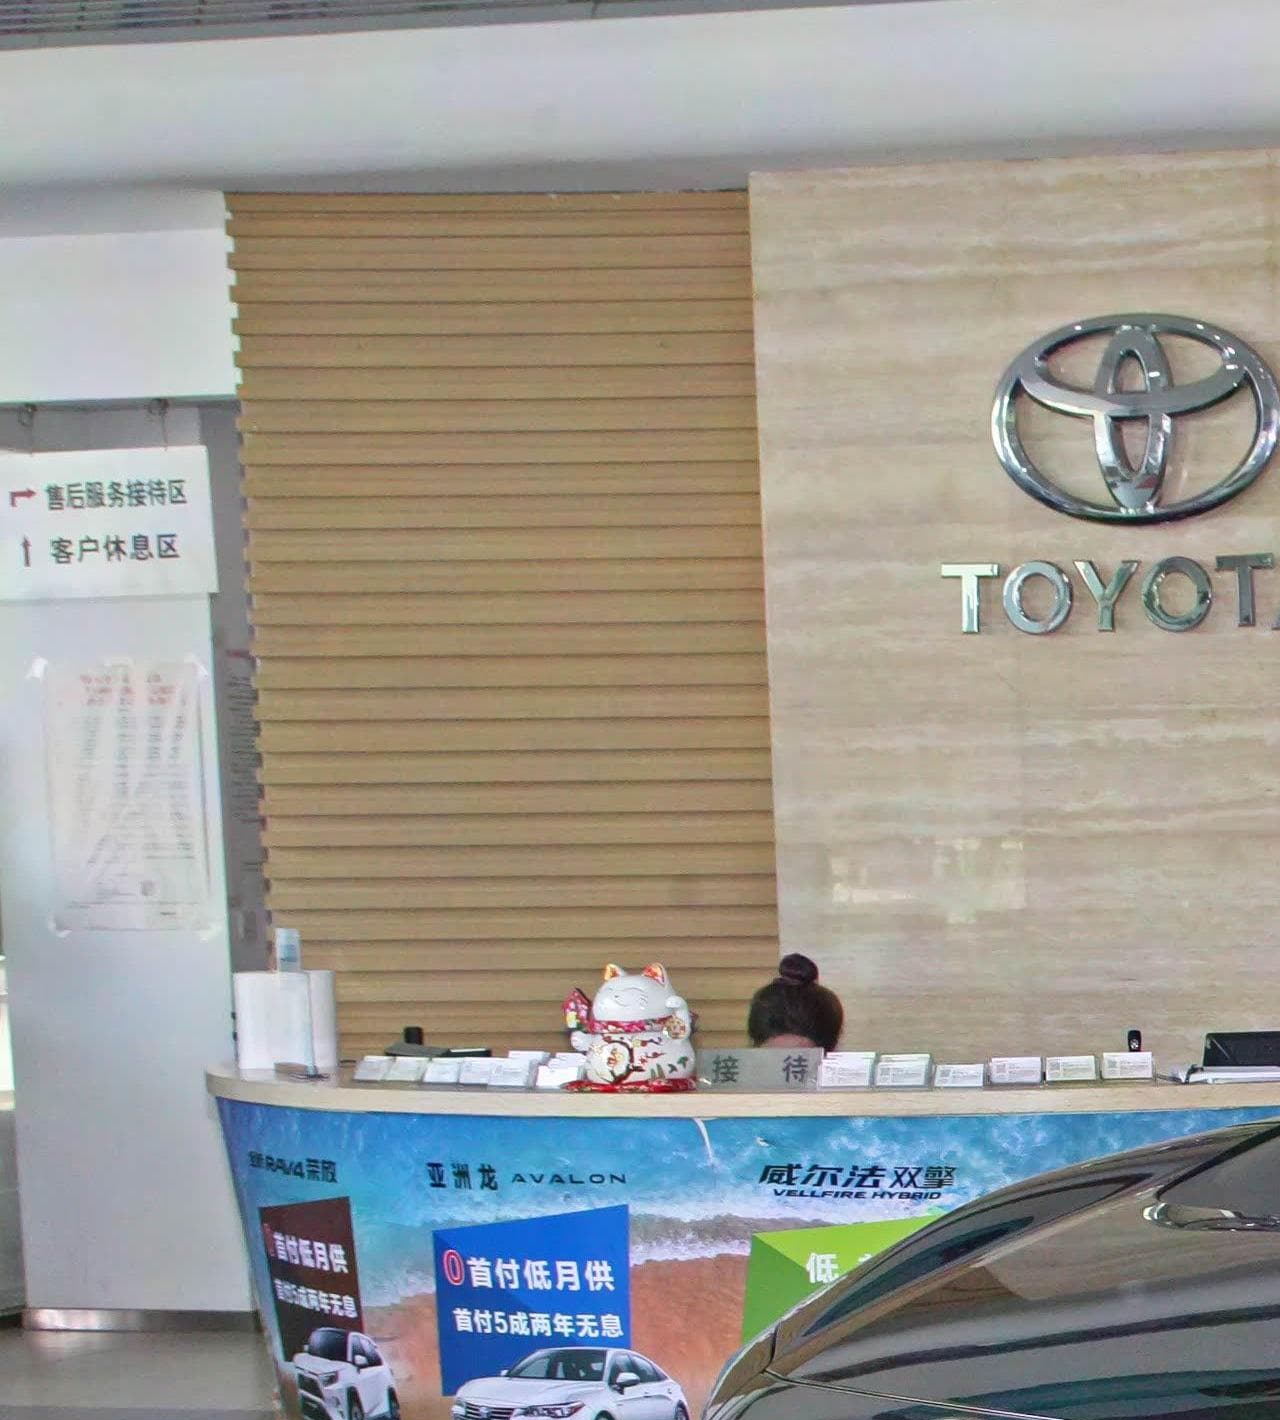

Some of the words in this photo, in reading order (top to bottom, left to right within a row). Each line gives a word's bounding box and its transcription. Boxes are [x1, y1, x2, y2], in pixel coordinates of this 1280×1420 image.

[46, 479, 187, 511] 售后服务接待区
[51, 534, 180, 564] 客户休息区
[426, 1162, 498, 1191] 亚洲龙
[512, 1173, 627, 1185] AVALON
[759, 1163, 957, 1190] 威尔法双擎
[773, 1188, 865, 1199] VELLFIRE
[872, 1191, 942, 1201] HYBRID
[453, 1308, 624, 1339] 首付5成两年无息
